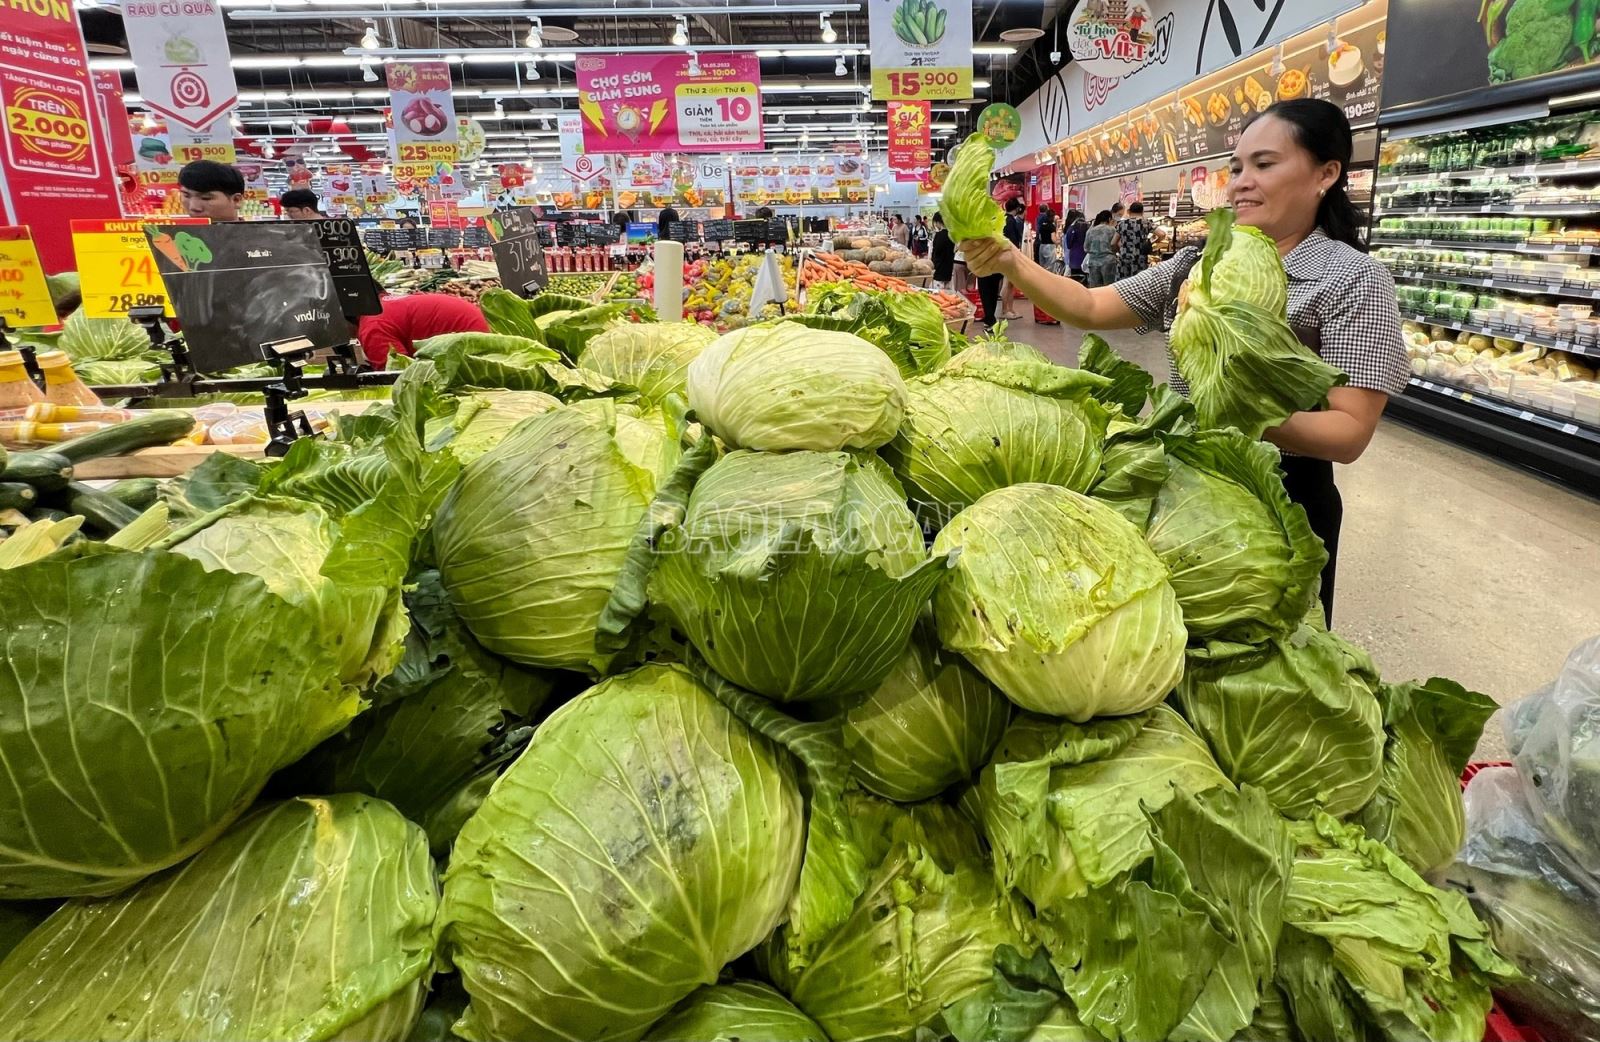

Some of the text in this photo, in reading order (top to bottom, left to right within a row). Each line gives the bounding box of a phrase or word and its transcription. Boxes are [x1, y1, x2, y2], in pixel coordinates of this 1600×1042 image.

[126, 5, 157, 16] RAU
[2, 45, 81, 67] ngày cùng GO!
[590, 71, 652, 89] CHỢ SỚM
[712, 68, 737, 76] 10:00
[624, 84, 662, 98] SUNG
[887, 72, 958, 96] 15.900
[926, 88, 955, 97] vnd/kg
[28, 98, 67, 115] TRÊN
[684, 104, 713, 116] GIẢM
[716, 97, 752, 122] 10
[898, 111, 919, 122] GIÁ
[11, 112, 87, 140] 2.000
[105, 219, 152, 231] KHUYẾ
[120, 255, 152, 287] 24
